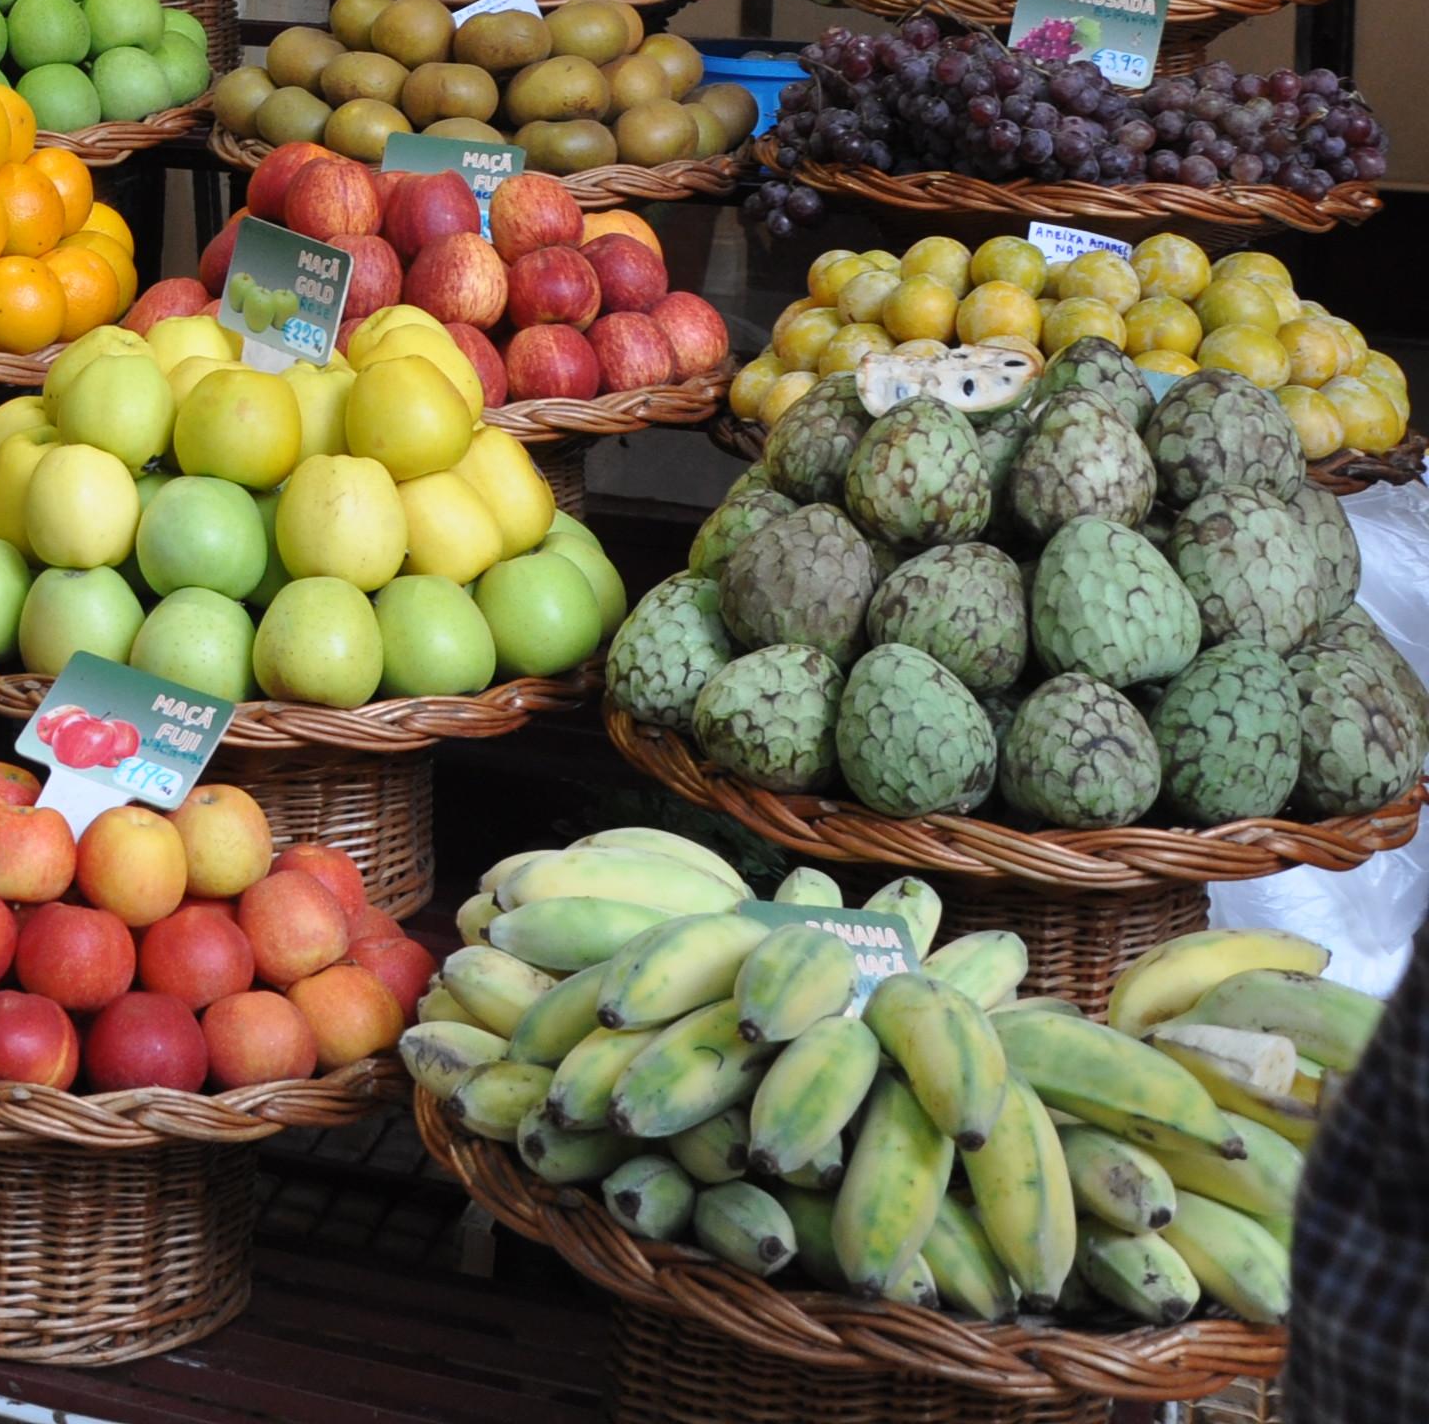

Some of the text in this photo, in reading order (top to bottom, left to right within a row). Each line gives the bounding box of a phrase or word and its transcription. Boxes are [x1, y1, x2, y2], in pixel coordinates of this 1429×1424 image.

[462, 151, 513, 174] MAÇÃ
[297, 249, 341, 282] MAÇÃ
[294, 275, 335, 305] GOLD
[151, 694, 217, 729] MAÇÃ
[155, 722, 203, 752] FUJI
